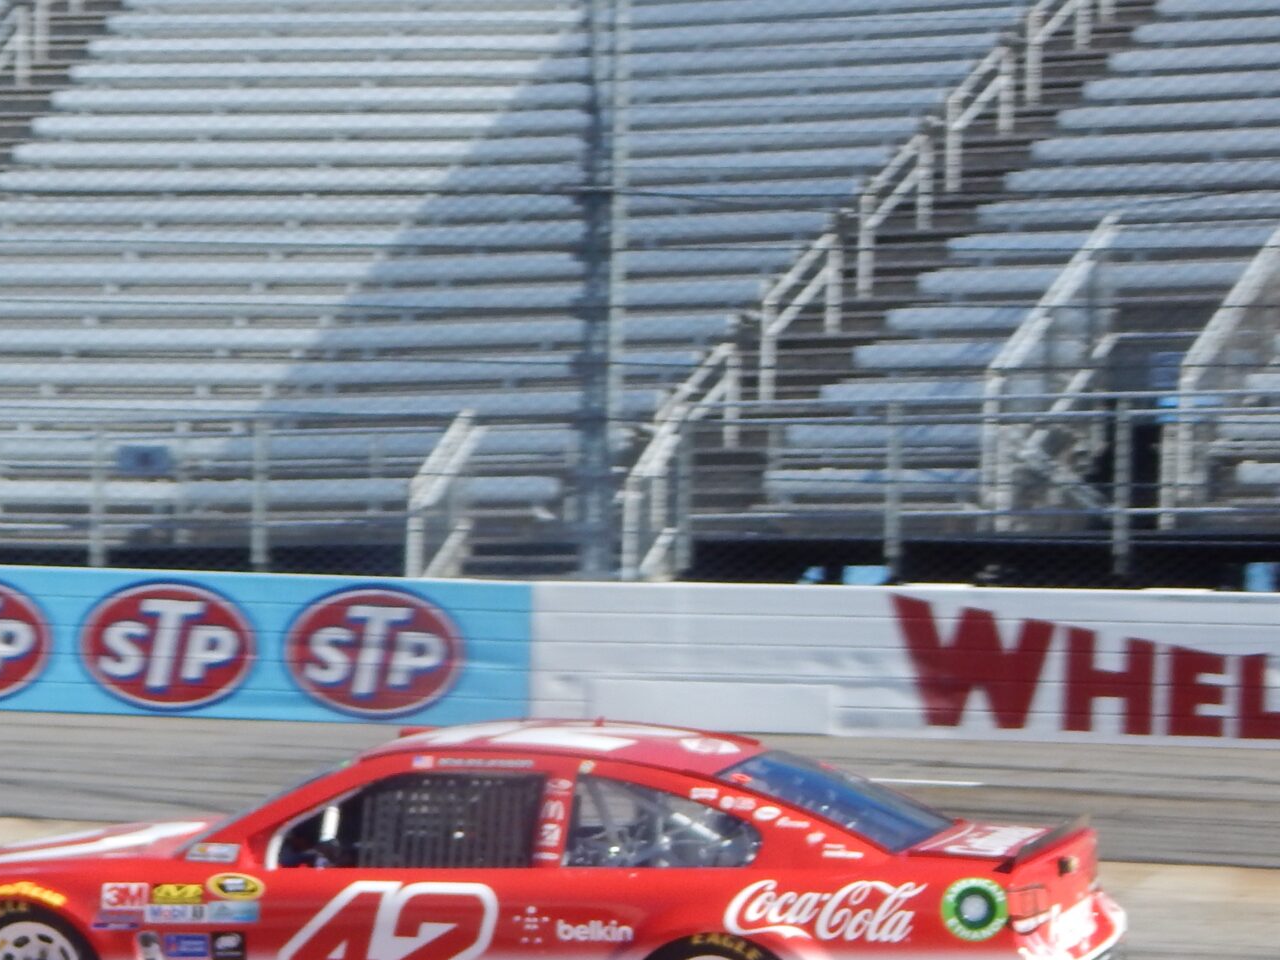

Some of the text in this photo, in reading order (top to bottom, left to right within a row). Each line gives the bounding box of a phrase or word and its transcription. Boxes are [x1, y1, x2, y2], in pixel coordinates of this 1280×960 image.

[96, 598, 240, 692] STP
[303, 604, 448, 699] STP
[888, 593, 1280, 740] WHEL
[107, 884, 147, 907] 3M
[556, 919, 634, 942] belkin
[723, 879, 929, 943] Coca-Cola
